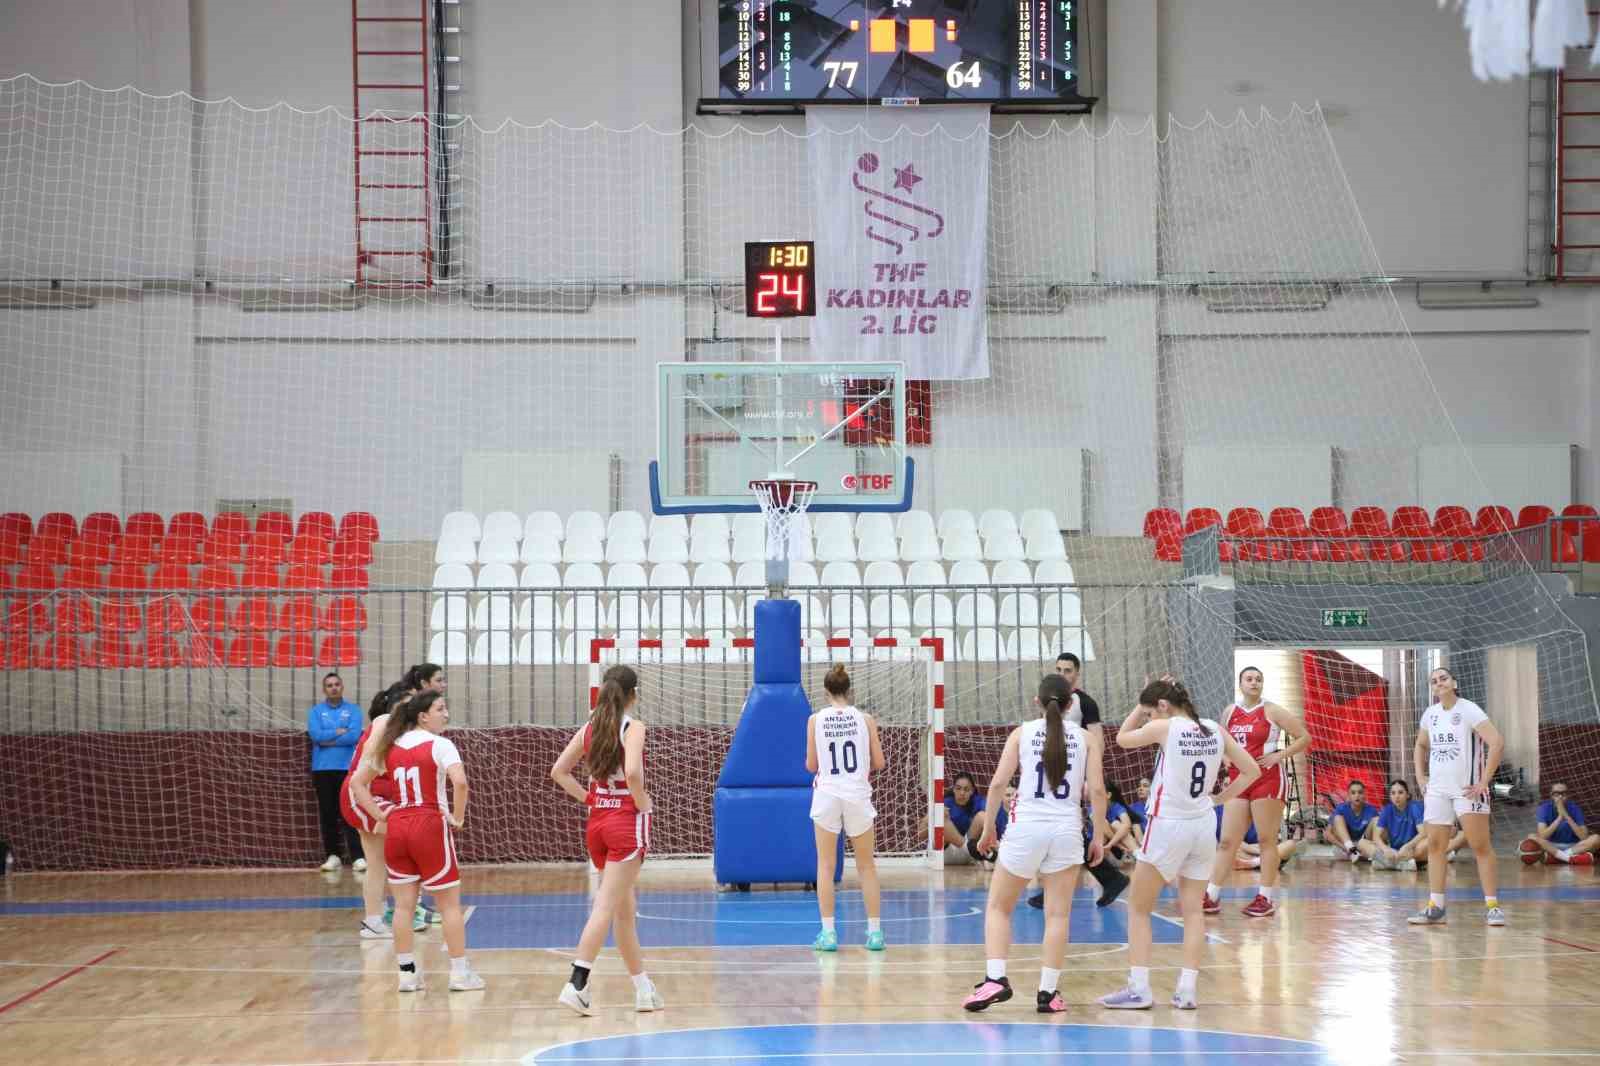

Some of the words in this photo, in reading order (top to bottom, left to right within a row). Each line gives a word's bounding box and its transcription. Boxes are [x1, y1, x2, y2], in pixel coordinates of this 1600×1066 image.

[742, 2, 750, 11] 9
[1019, 1, 1031, 11] 11
[1039, 1, 1047, 11] 2
[1060, 1, 1072, 11] 14
[739, 12, 750, 21] 10
[759, 12, 766, 21] 2
[779, 12, 791, 21] 18
[1019, 11, 1031, 21] 13
[739, 22, 750, 31] 11
[1019, 21, 1031, 31] 16
[1064, 21, 1072, 31] 1
[739, 32, 750, 41] 12
[783, 32, 791, 41] 8
[783, 42, 791, 51] 6
[1019, 41, 1031, 51] 21
[1064, 41, 1072, 51] 5
[739, 52, 750, 61] 14
[779, 52, 791, 61] 13
[1019, 51, 1031, 61] 22
[739, 61, 750, 71] 15
[1019, 61, 1031, 71] 24
[738, 71, 750, 81] 30
[823, 61, 859, 89] 77
[946, 61, 982, 89] 64
[1019, 70, 1031, 80] 54
[1019, 81, 1031, 90] 99
[769, 246, 808, 267] 1:30
[873, 263, 928, 282] THF
[757, 274, 803, 312] 24
[826, 288, 972, 308] KADINLAR
[860, 315, 884, 335] 2.
[893, 309, 937, 335] LİG
[858, 474, 894, 489] TBF
[828, 740, 858, 775] 10
[1190, 761, 1206, 799] 8
[393, 766, 423, 808] 11
